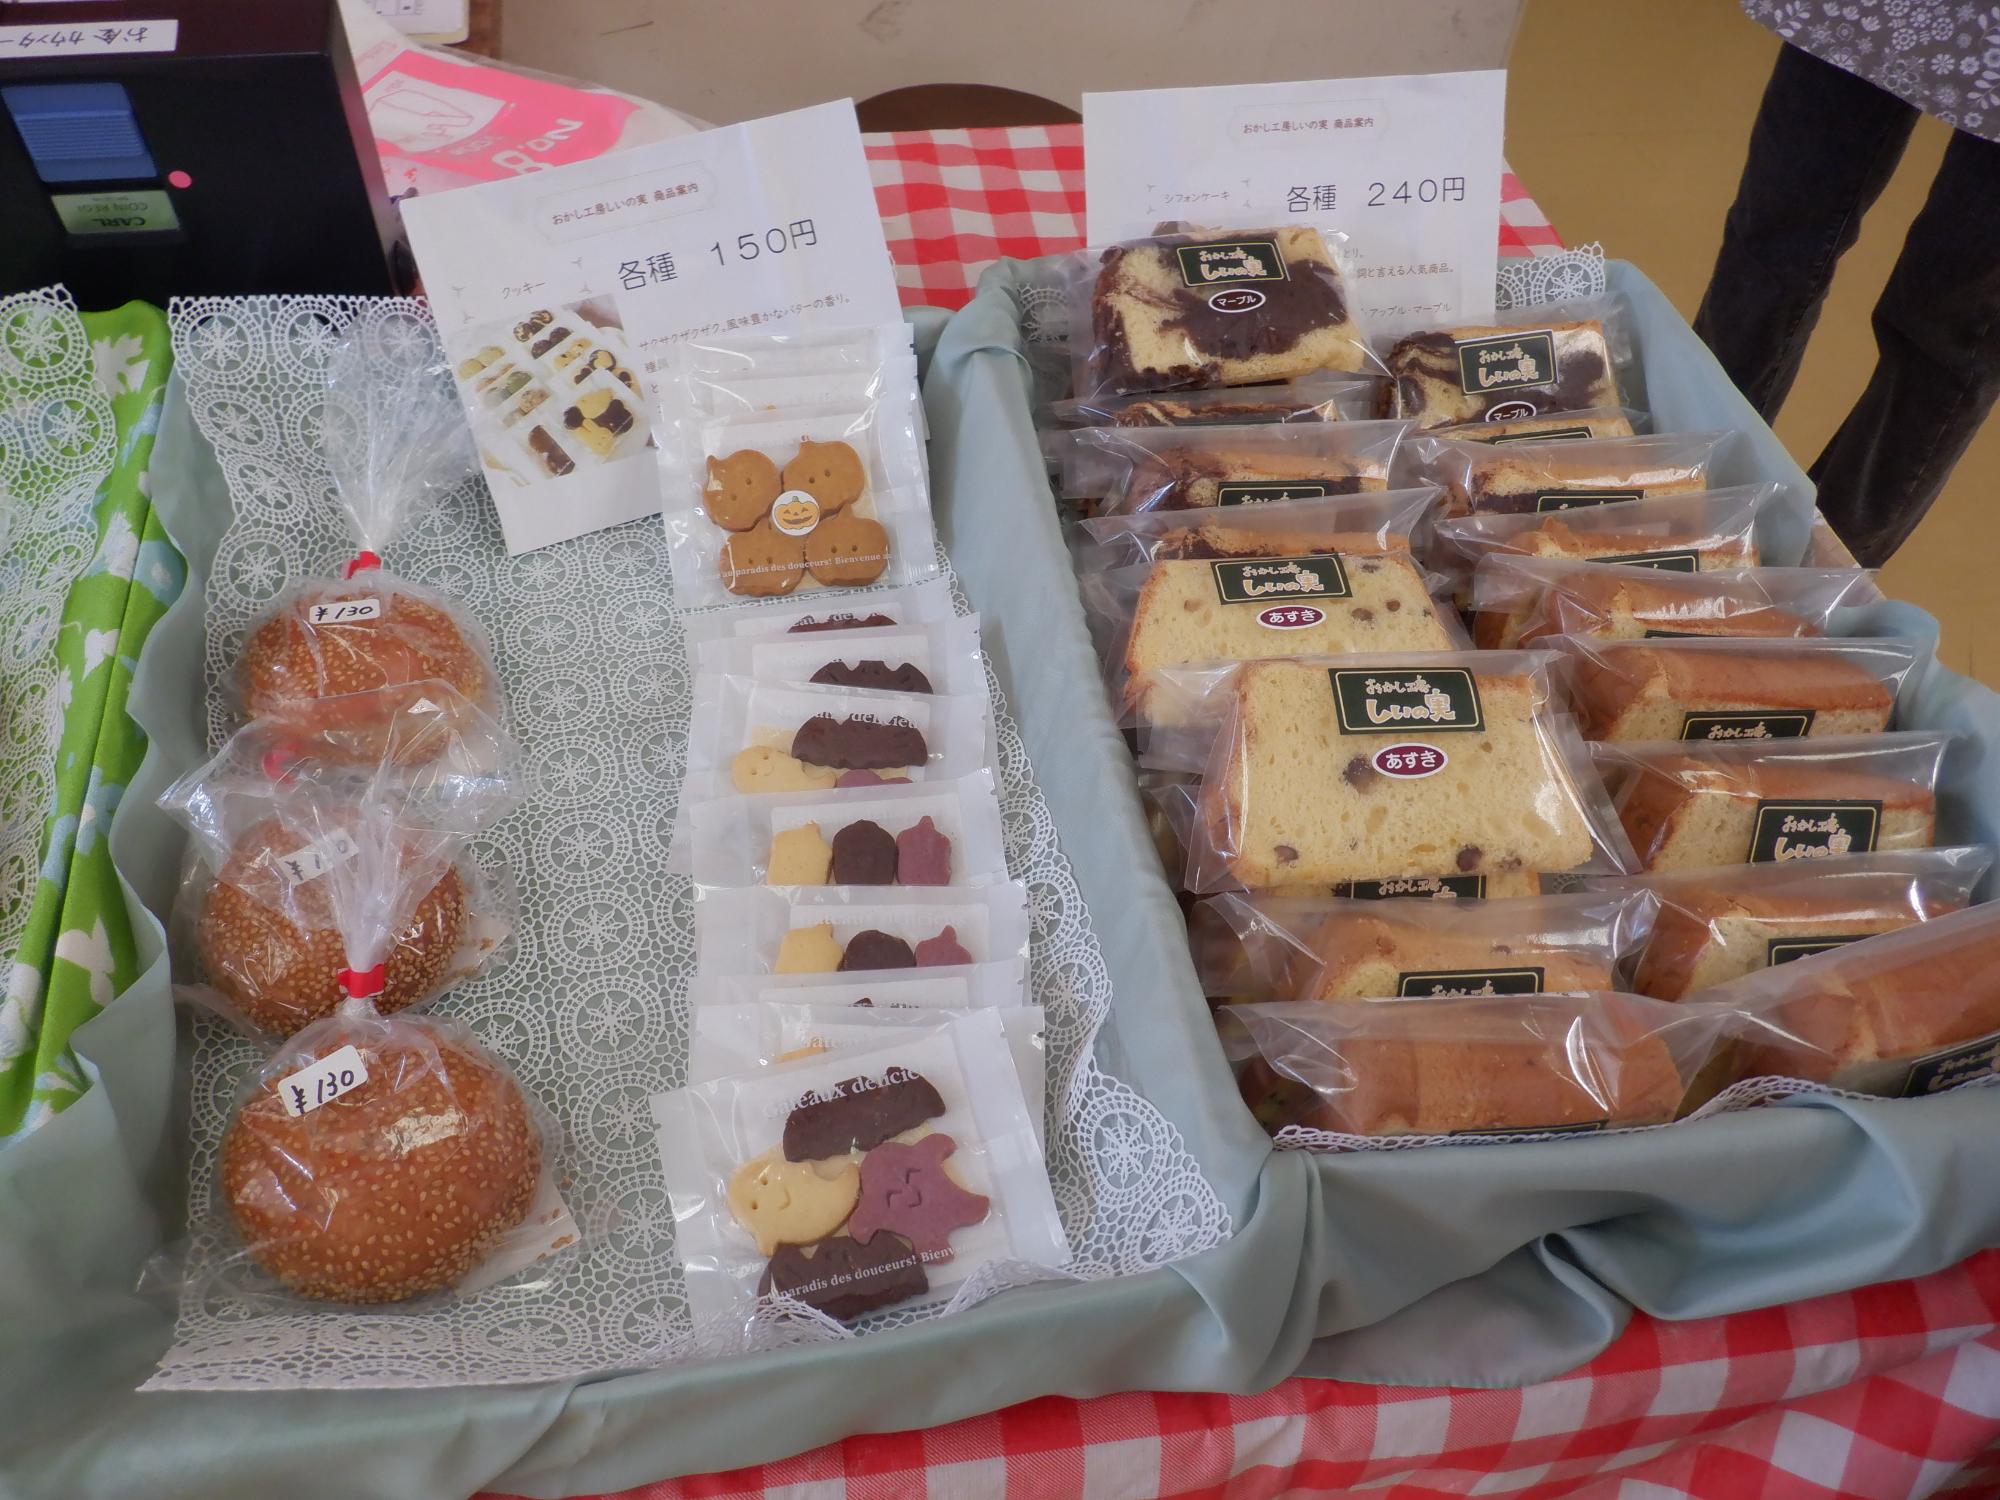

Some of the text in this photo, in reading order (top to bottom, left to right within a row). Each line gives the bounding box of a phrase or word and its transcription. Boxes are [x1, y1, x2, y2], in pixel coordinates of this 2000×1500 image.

[94, 27, 148, 45] お金
[1163, 190, 1230, 205] シフォンケーキ
[1286, 176, 1465, 213] 各種 240円
[92, 216, 147, 227] CARL
[617, 218, 818, 291] 各種 150円
[501, 281, 546, 300] クッキー
[1216, 294, 1257, 307] マーブル
[1493, 408, 1529, 421] マーブル
[736, 564, 769, 578] paradis
[770, 563, 787, 572] des
[834, 553, 882, 566] Bienvenue
[1269, 609, 1317, 623] あずき
[1365, 688, 1456, 725] しいの実
[1385, 750, 1437, 770] あずき
[781, 1279, 828, 1299] paradis
[830, 1272, 853, 1287] des
[854, 1254, 917, 1281] douceurs!
